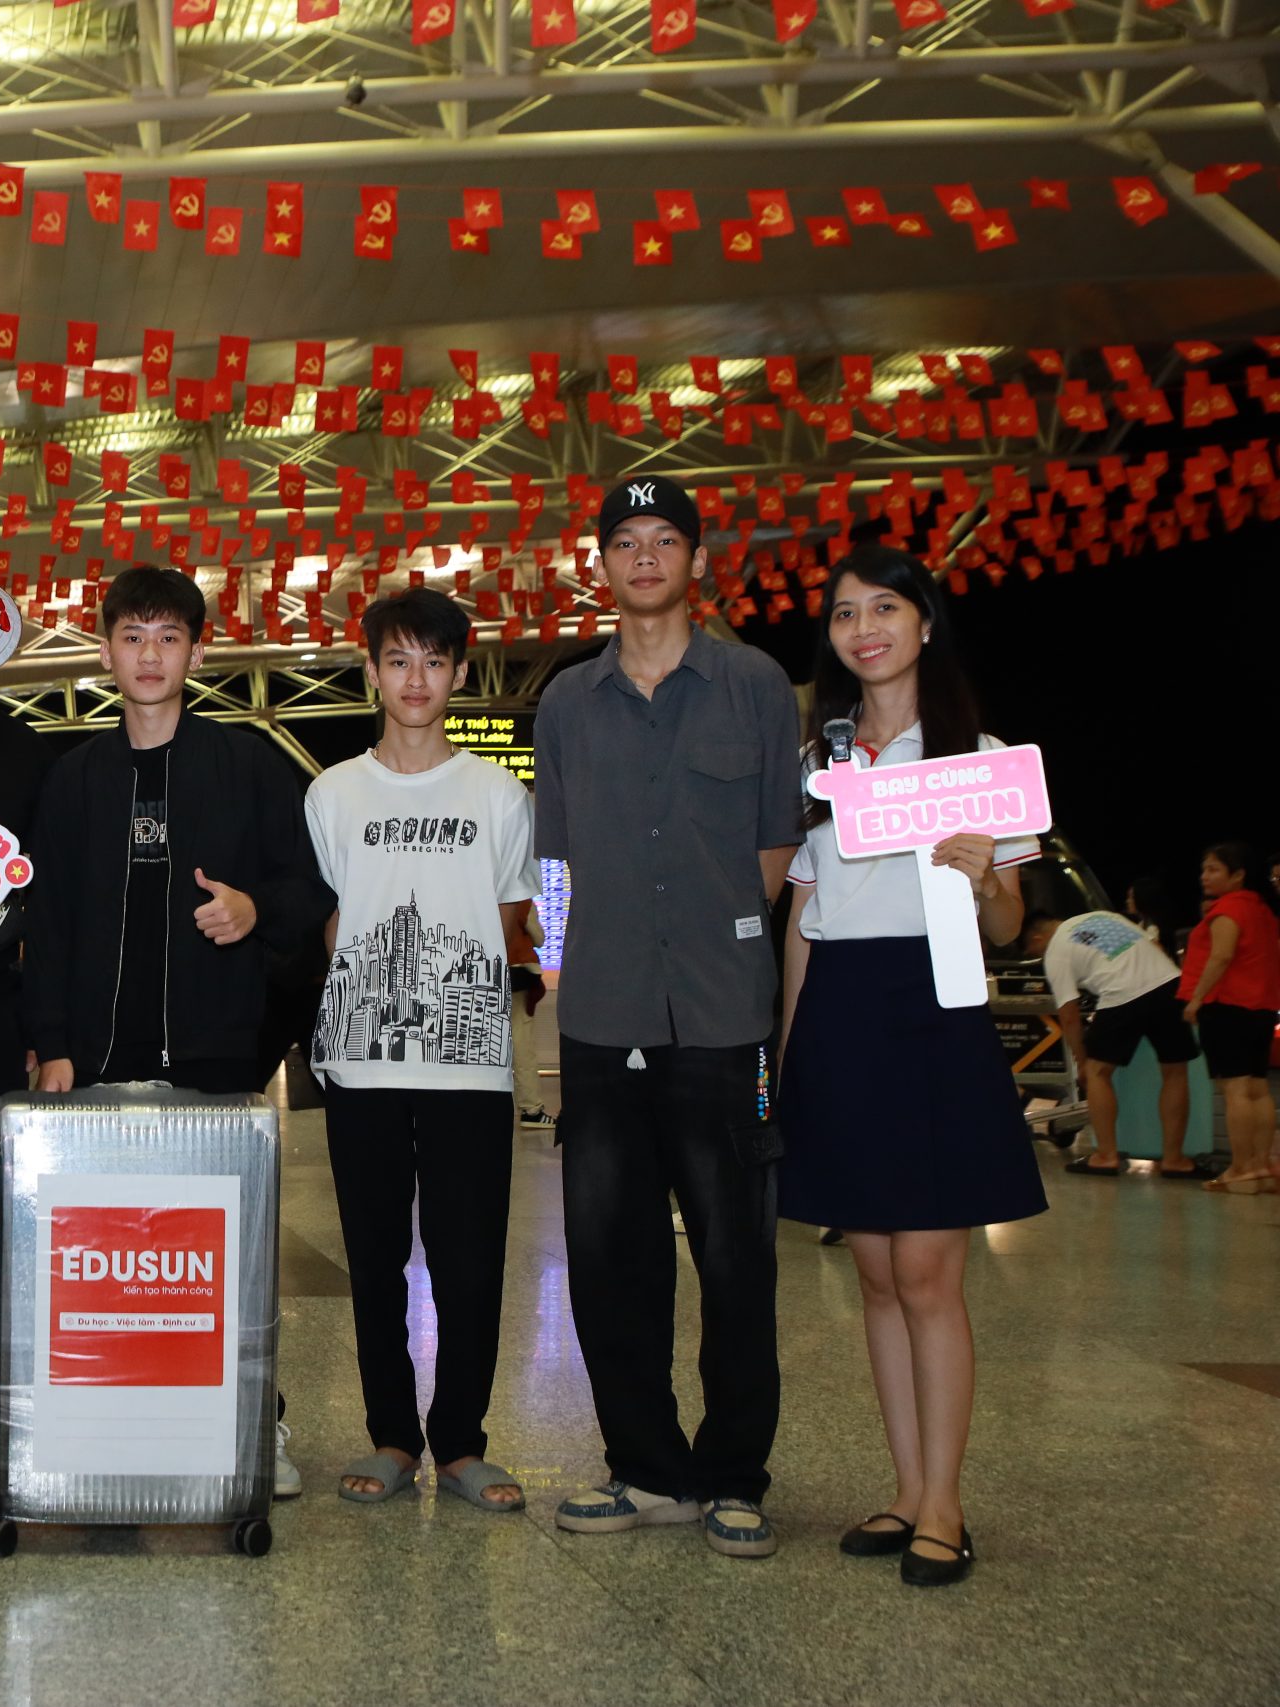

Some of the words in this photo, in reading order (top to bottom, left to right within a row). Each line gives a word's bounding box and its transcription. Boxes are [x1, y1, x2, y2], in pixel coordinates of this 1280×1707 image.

[627, 482, 656, 507] NY
[872, 775, 919, 798] BAY
[856, 787, 1026, 843] EDUSUN
[364, 817, 477, 846] GROUND
[62, 1250, 213, 1282] EDUSUN
[123, 1285, 143, 1295] Kiến
[144, 1286, 160, 1296] tạo
[162, 1286, 188, 1295] thành
[189, 1286, 213, 1297] công
